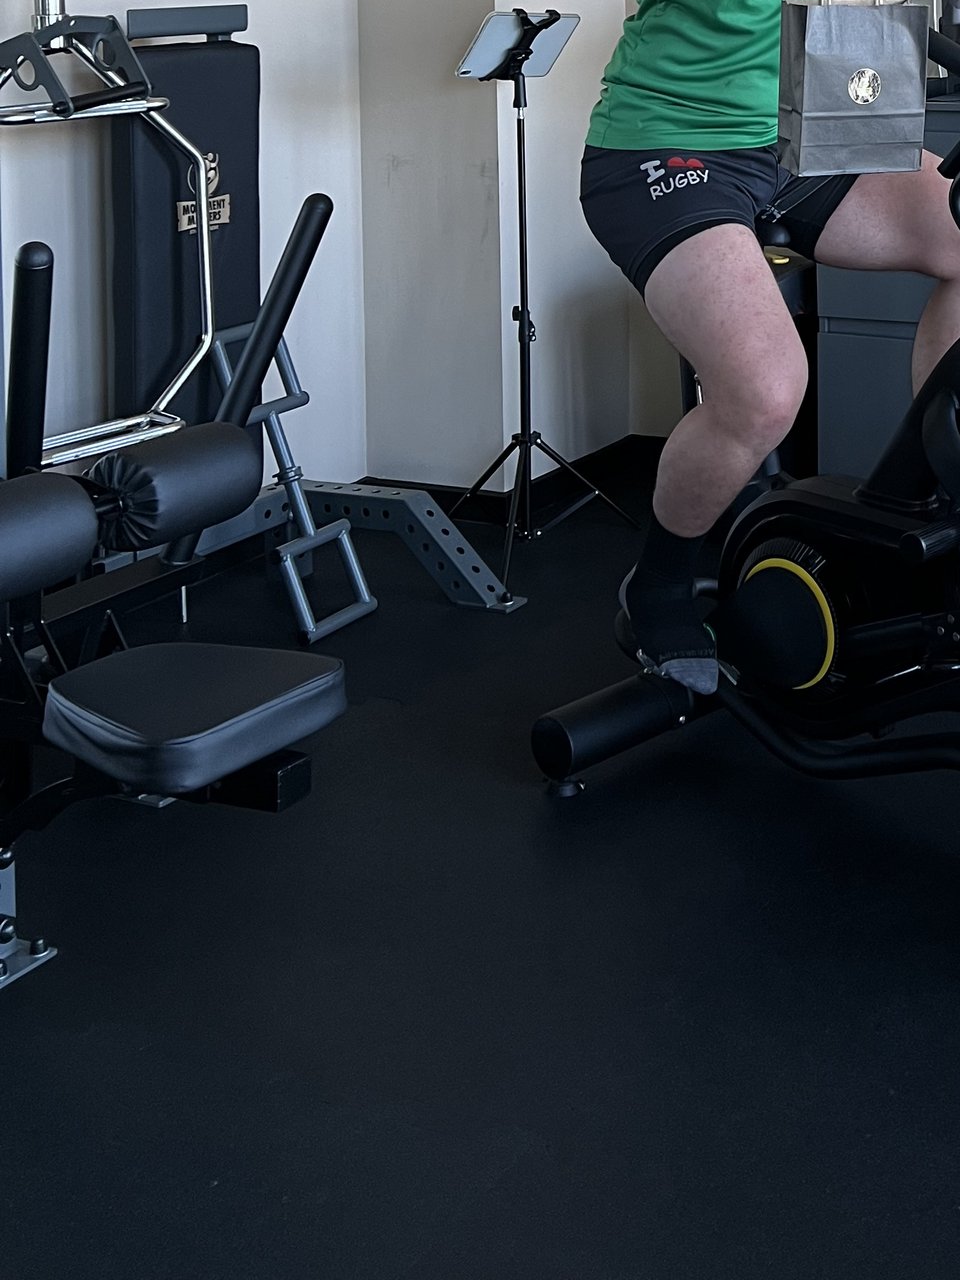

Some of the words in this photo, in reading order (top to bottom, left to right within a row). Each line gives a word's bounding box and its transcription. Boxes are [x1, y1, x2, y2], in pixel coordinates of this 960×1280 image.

[640, 160, 665, 183] I
[649, 169, 709, 201] RUGBY
[182, 199, 226, 216] MOENT
[187, 210, 222, 226] MERS
